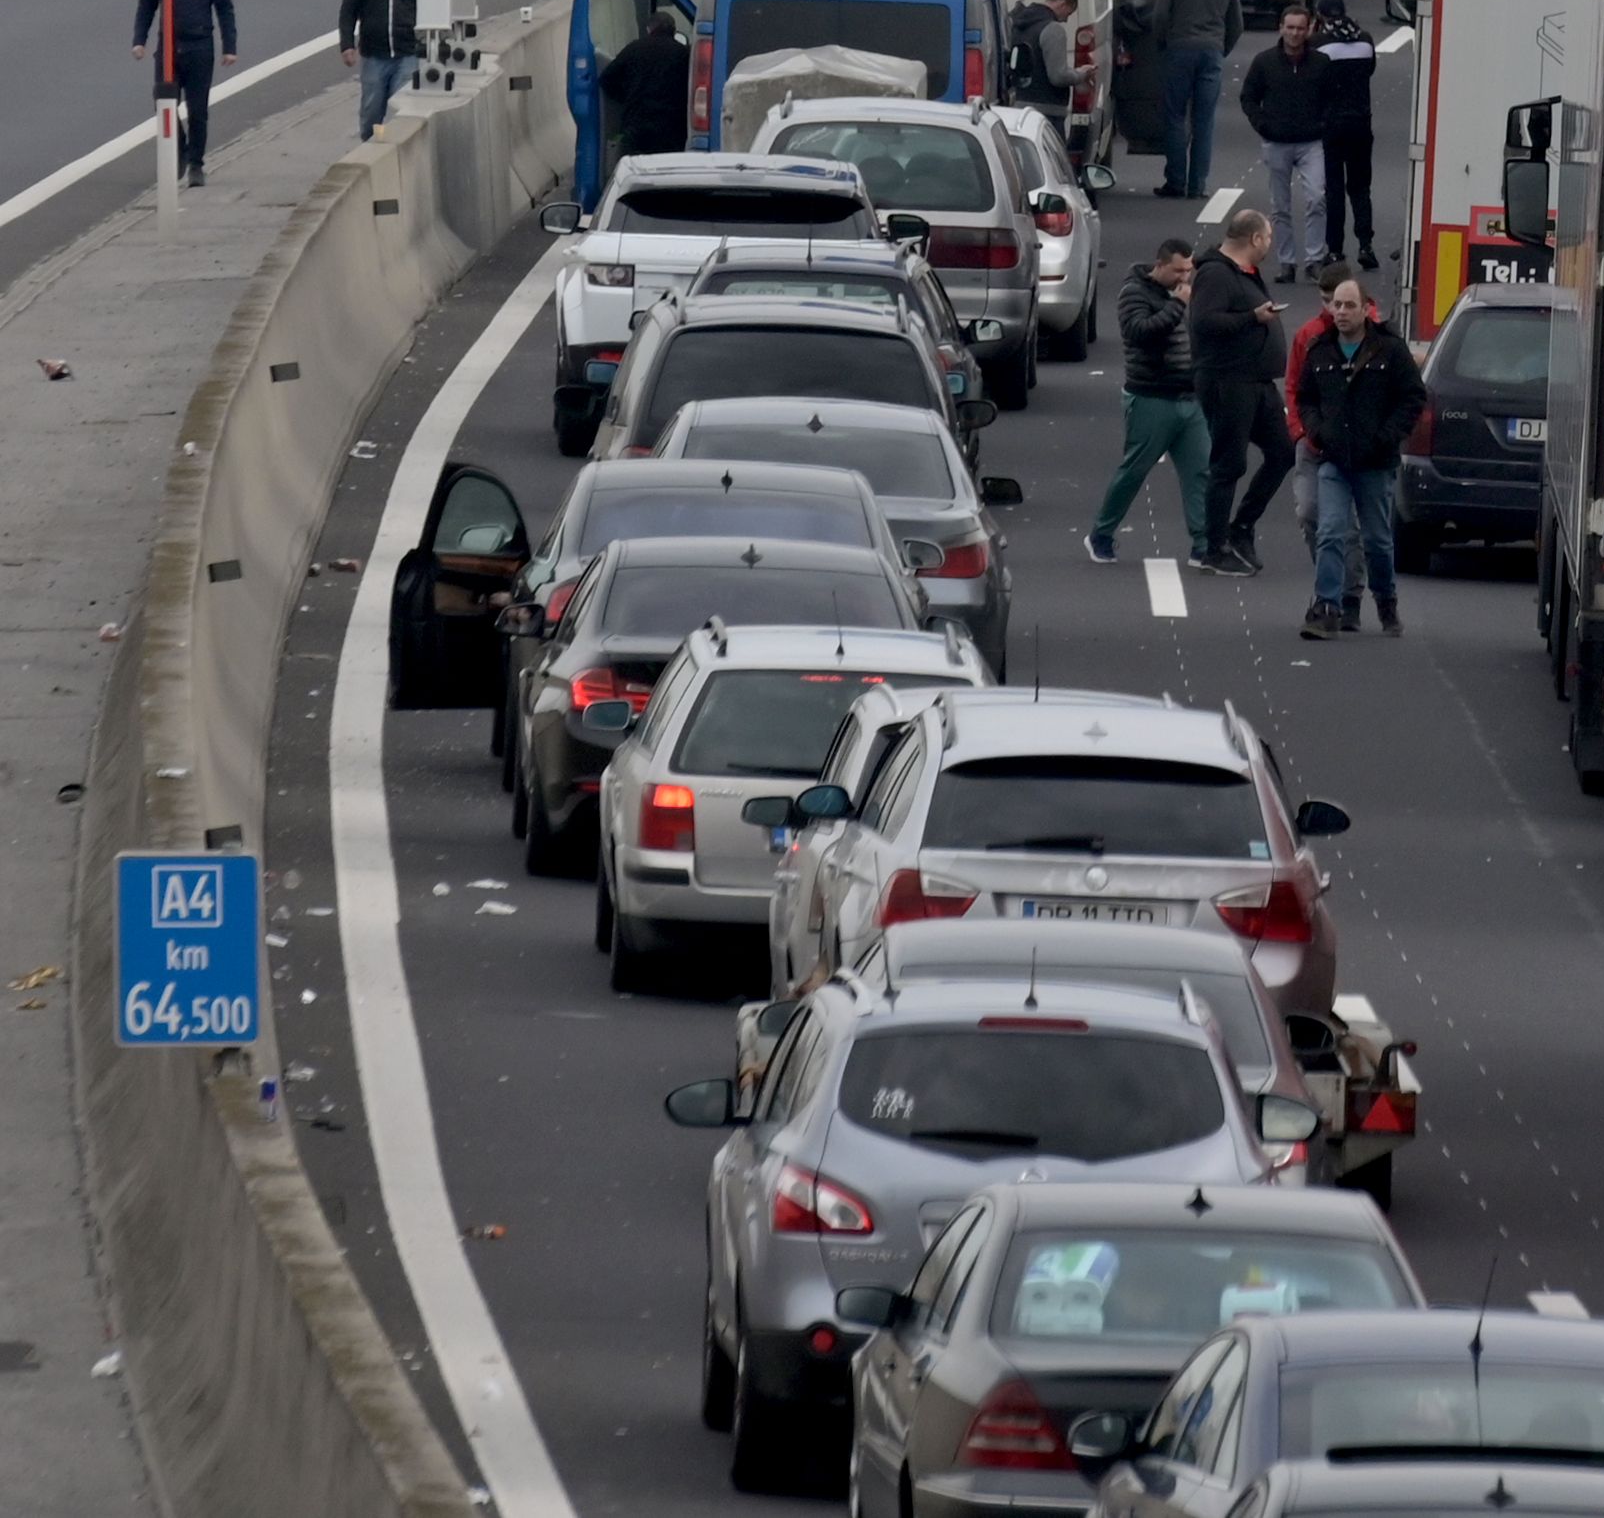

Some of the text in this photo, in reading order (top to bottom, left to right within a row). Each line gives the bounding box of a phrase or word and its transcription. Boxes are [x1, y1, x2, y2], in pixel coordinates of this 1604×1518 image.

[1519, 421, 1543, 438] DJ
[159, 873, 216, 920] A4
[165, 939, 210, 972] km
[124, 979, 252, 1042] 64,500
